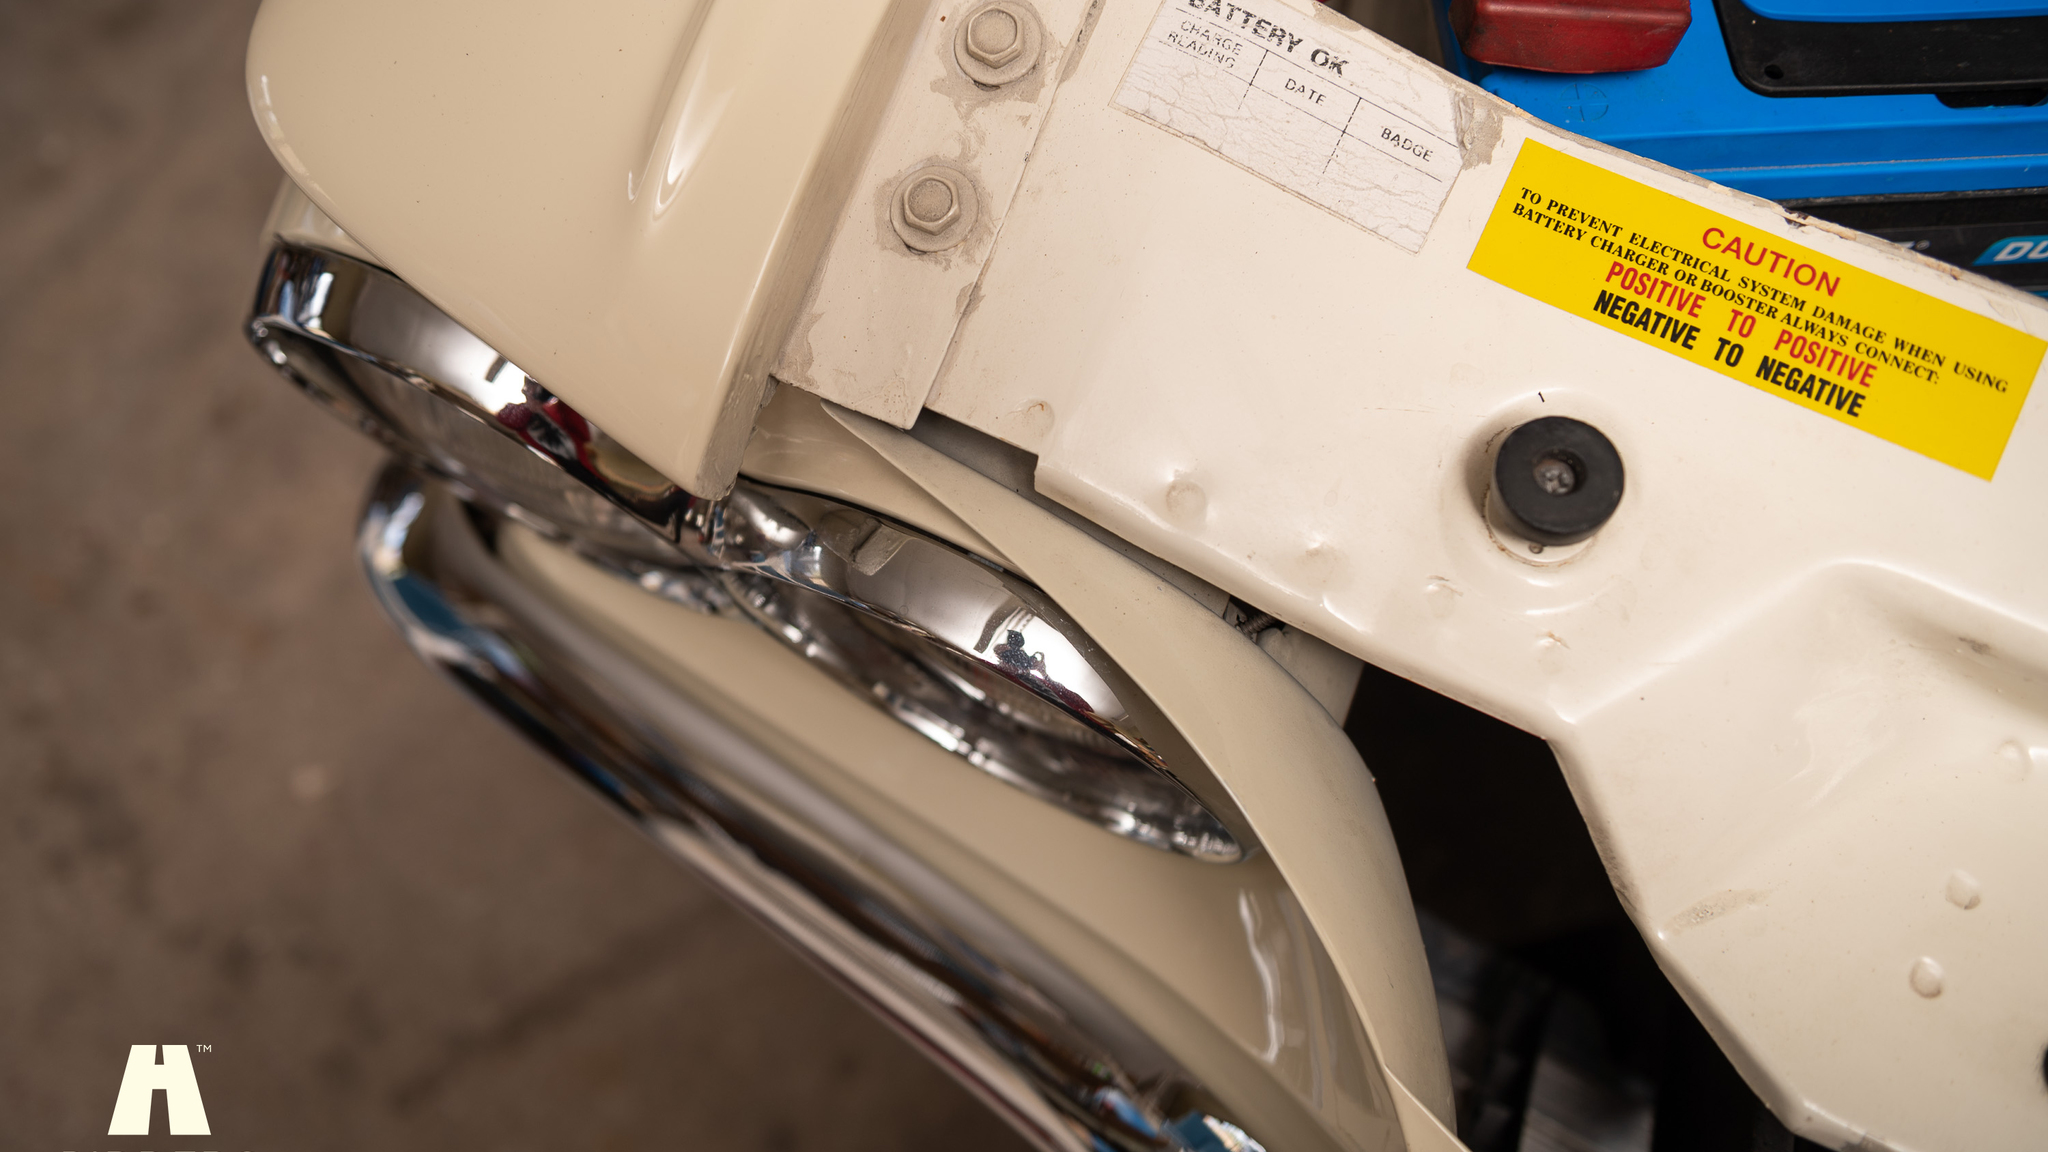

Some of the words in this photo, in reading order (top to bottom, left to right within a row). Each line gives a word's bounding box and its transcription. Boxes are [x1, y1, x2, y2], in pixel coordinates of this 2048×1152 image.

[1167, 30, 1236, 69] READING
[1180, 19, 1243, 56] CHARGE
[1310, 48, 1349, 78] OK
[1284, 77, 1327, 106] DATE
[1380, 126, 1434, 162] BADGE
[1702, 227, 1841, 297] CAUTION
[1512, 202, 1587, 241] BATTERY
[1590, 235, 1670, 275] CHARGER
[1674, 268, 1698, 287] OR
[1700, 278, 1779, 319] BOOSTER
[1780, 312, 1849, 347] ALWAYS
[1855, 341, 1940, 385] CONNECT:
[1520, 186, 1542, 205] TO
[1546, 199, 1623, 238] PREVENT
[1628, 232, 1731, 282] ELECTRICAL
[1738, 276, 1807, 312] SYSTEM
[1812, 305, 1887, 344] DAMAGE
[1893, 336, 1946, 367] WHEN
[1953, 361, 2009, 393] USING
[1605, 260, 1707, 318] POSITIVE
[1726, 308, 1757, 339] TO
[1773, 328, 1878, 388] POSITIVE
[1592, 289, 1701, 350] NEGATIVE
[1713, 336, 1744, 368] TO
[1755, 354, 1866, 418] NEGATIVE
